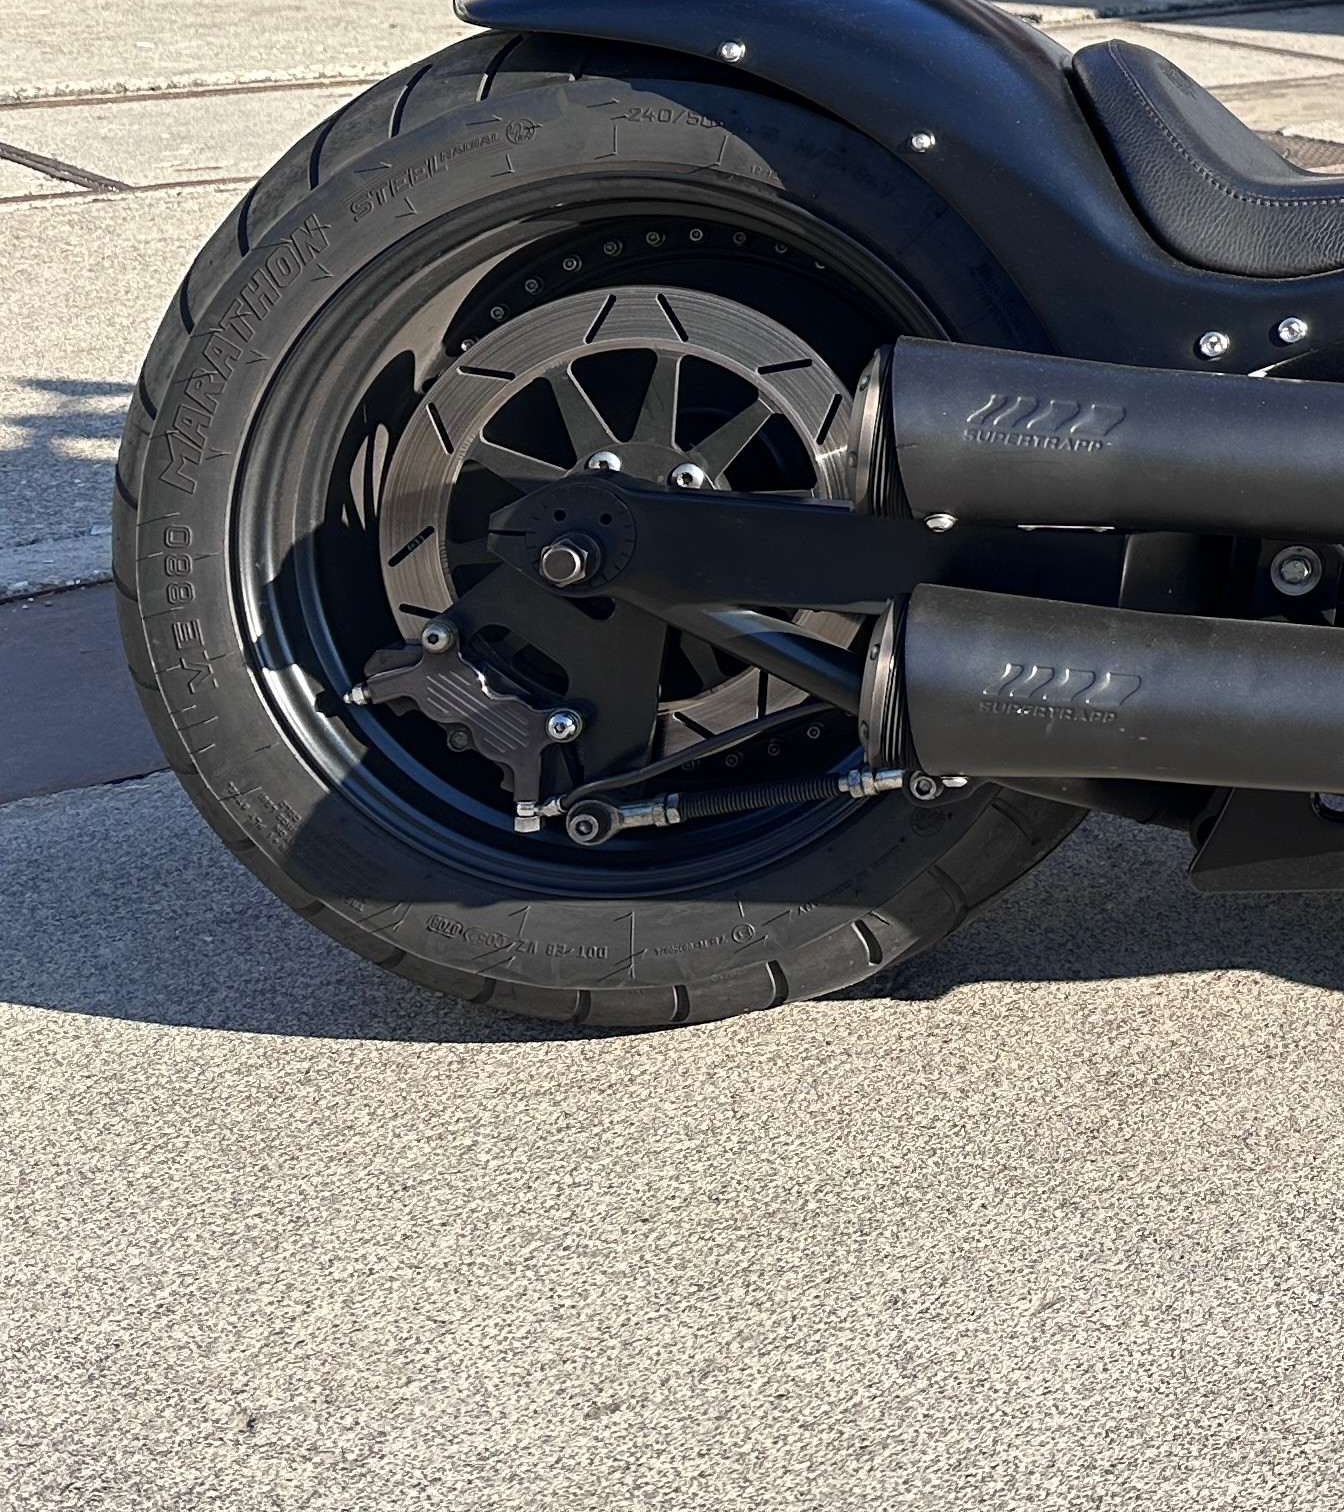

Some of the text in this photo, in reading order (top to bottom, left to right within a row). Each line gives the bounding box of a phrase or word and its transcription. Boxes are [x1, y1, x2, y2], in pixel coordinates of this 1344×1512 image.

[350, 153, 449, 223] STEEL
[159, 213, 332, 495] MARATHON
[963, 428, 1104, 452] SUPERTRAPP
[164, 524, 197, 605] 880
[979, 701, 1117, 724] SUPERTRAPP
